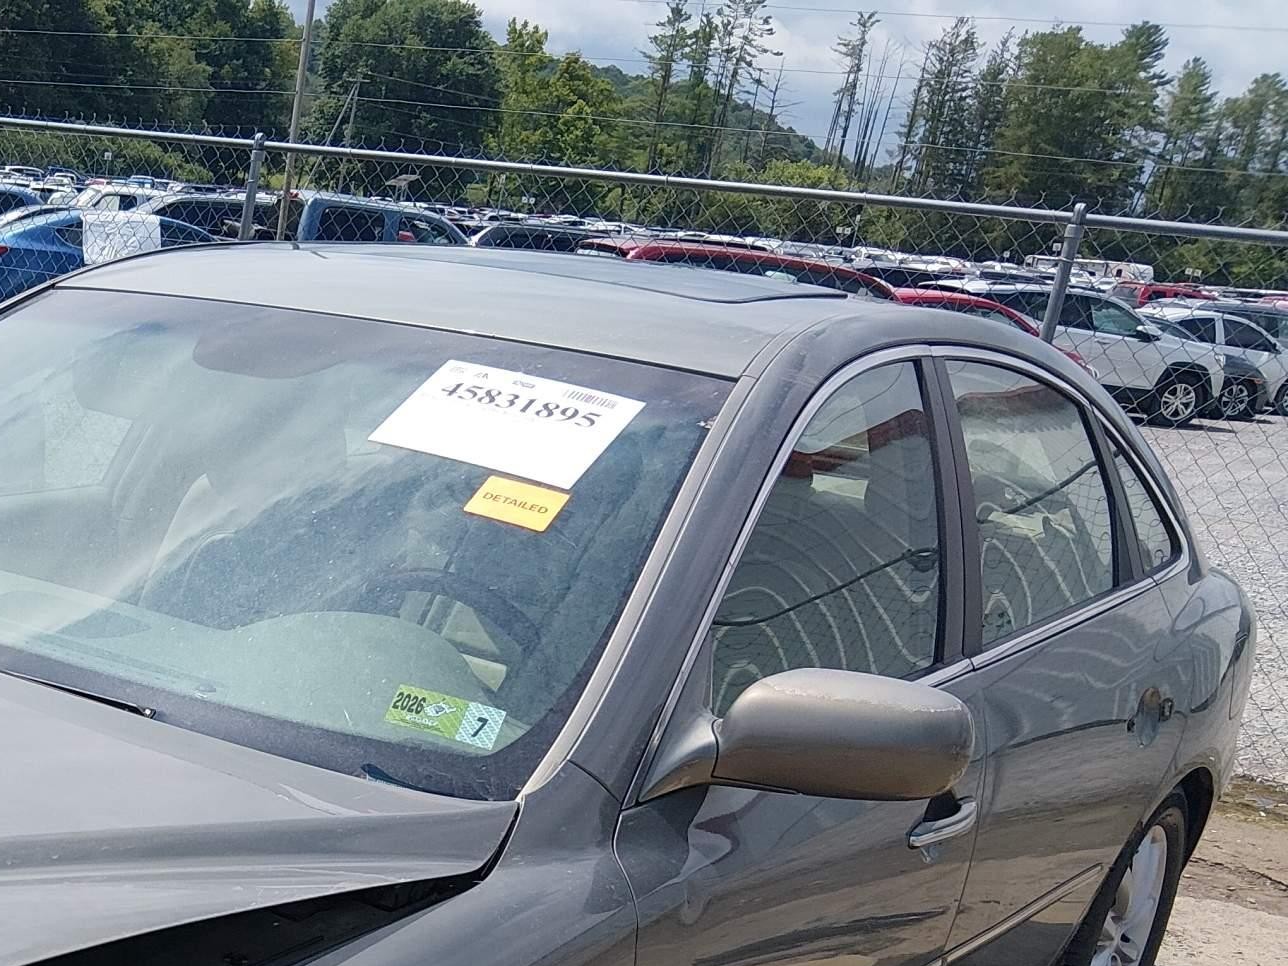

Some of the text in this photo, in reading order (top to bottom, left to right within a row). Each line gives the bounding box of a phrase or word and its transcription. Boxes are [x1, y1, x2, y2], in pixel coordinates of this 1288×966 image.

[441, 382, 602, 428] 45831895
[482, 491, 549, 514] DETAILED
[391, 691, 427, 715] 2026
[471, 716, 489, 738] 7
